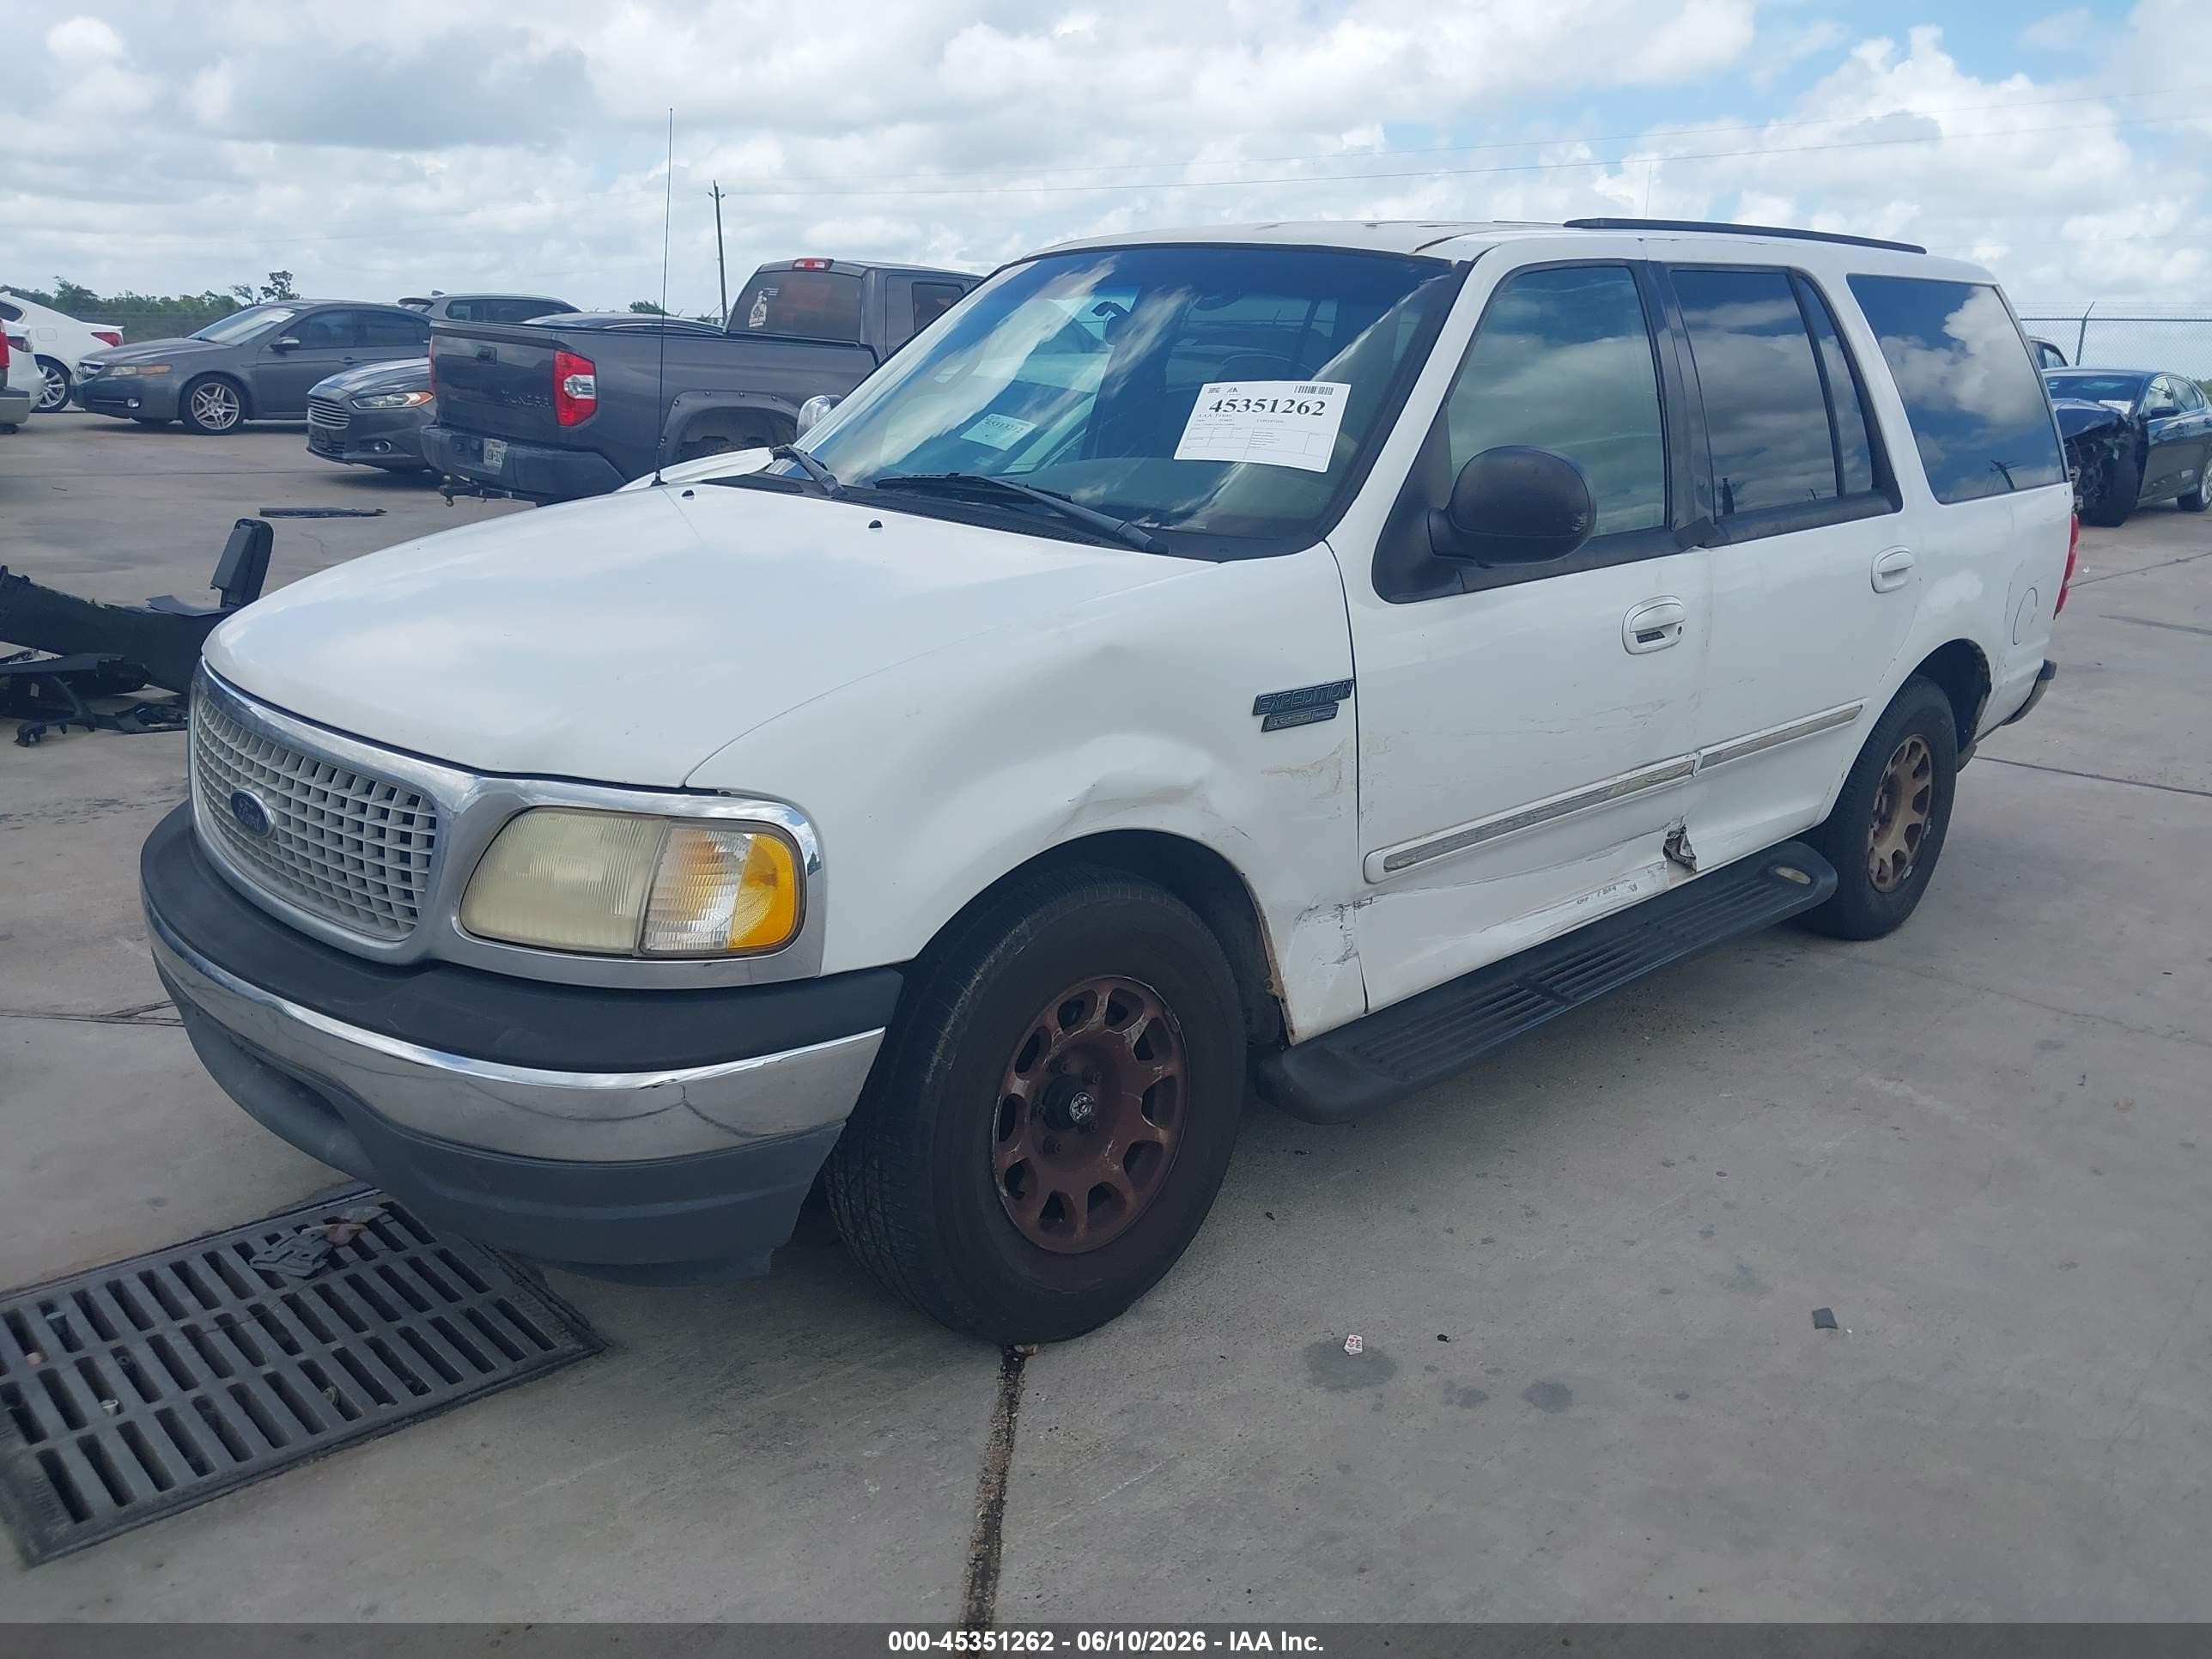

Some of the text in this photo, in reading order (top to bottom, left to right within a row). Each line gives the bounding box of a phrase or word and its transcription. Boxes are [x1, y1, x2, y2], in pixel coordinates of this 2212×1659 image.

[1208, 398, 1327, 416] 45351262
[1256, 681, 1354, 714] EXPEDITION
[239, 799, 262, 831] Ford
